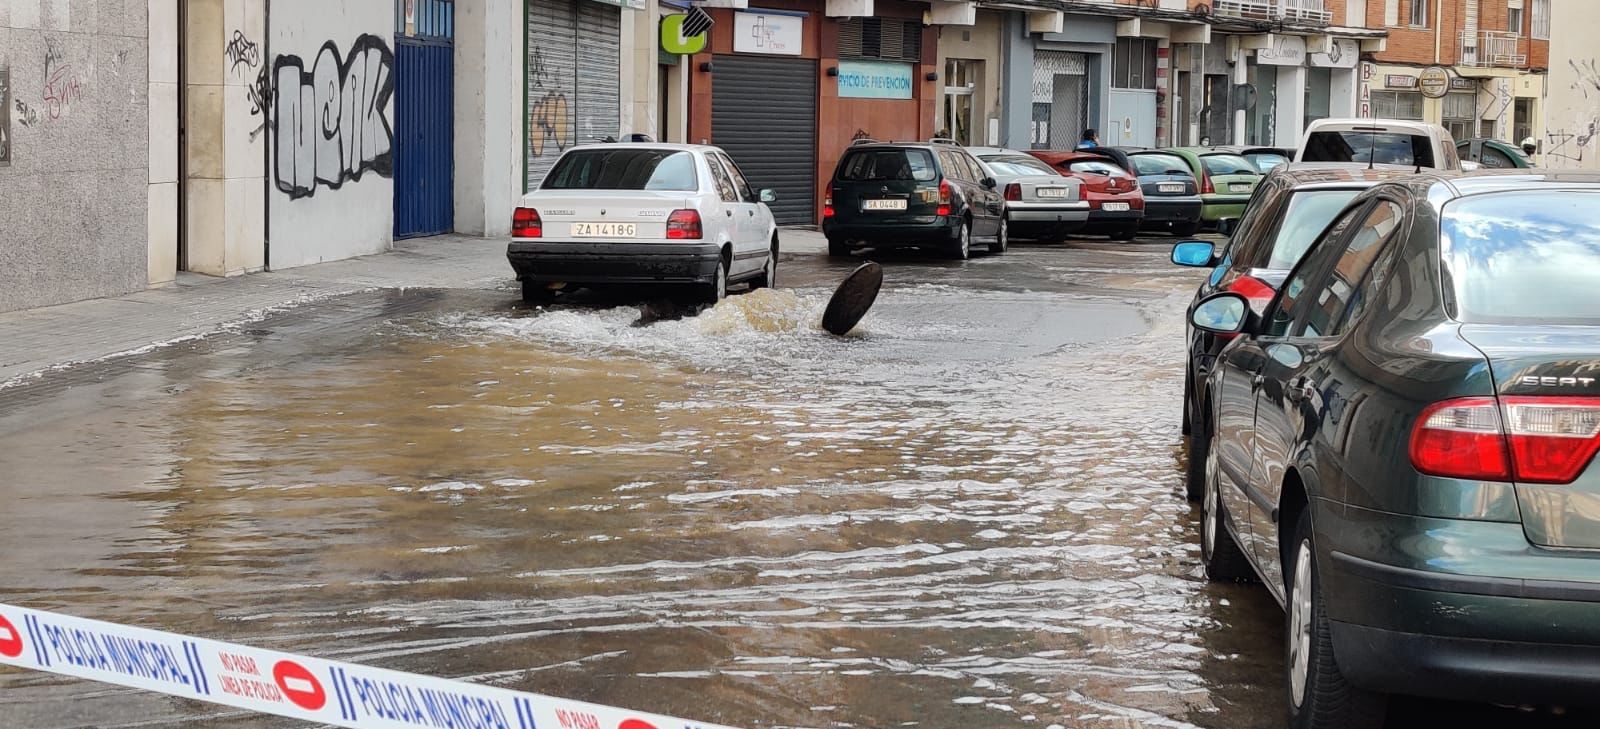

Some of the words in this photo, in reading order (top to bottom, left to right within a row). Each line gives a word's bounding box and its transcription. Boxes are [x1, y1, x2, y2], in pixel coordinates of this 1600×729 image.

[862, 75, 869, 88] DE
[872, 74, 910, 90] PREVENCIÓN
[1362, 64, 1371, 118] BAR
[1521, 375, 1595, 387] SEAT
[43, 624, 111, 671] POLICIA
[101, 633, 190, 685] MUNICIPAL
[218, 651, 234, 671] NO
[231, 653, 261, 676] PASAR
[217, 673, 241, 696] LINEA
[238, 678, 254, 698] DE
[351, 676, 428, 726] POLICIA
[555, 709, 572, 729] NO
